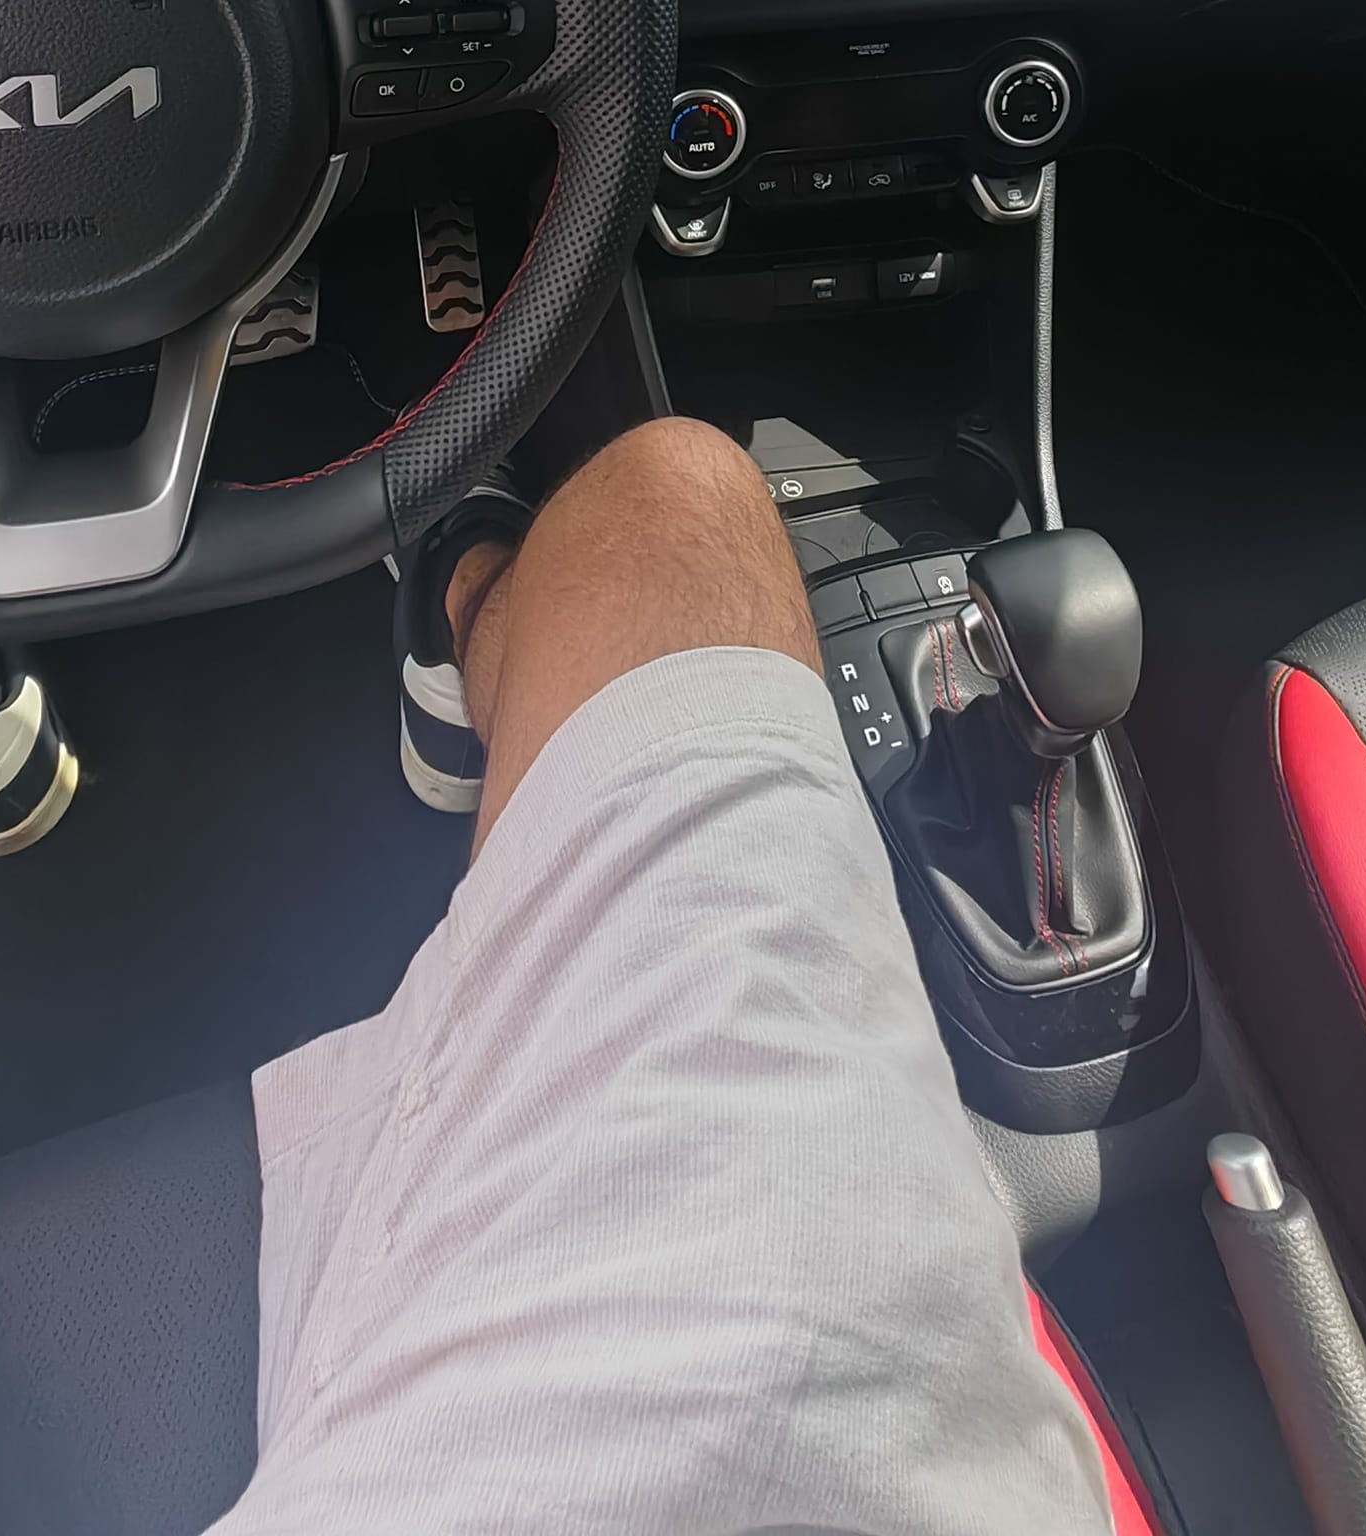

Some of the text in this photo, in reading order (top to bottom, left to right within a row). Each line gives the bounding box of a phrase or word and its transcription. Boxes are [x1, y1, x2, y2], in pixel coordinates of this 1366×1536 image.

[461, 40, 480, 52] SET
[378, 84, 396, 96] OK
[1022, 113, 1038, 123] A/C
[688, 142, 716, 152] AUTO
[759, 180, 777, 192] OFF
[898, 272, 915, 283] 12V
[840, 663, 858, 682] R
[851, 693, 870, 713] N
[863, 726, 881, 747] D
